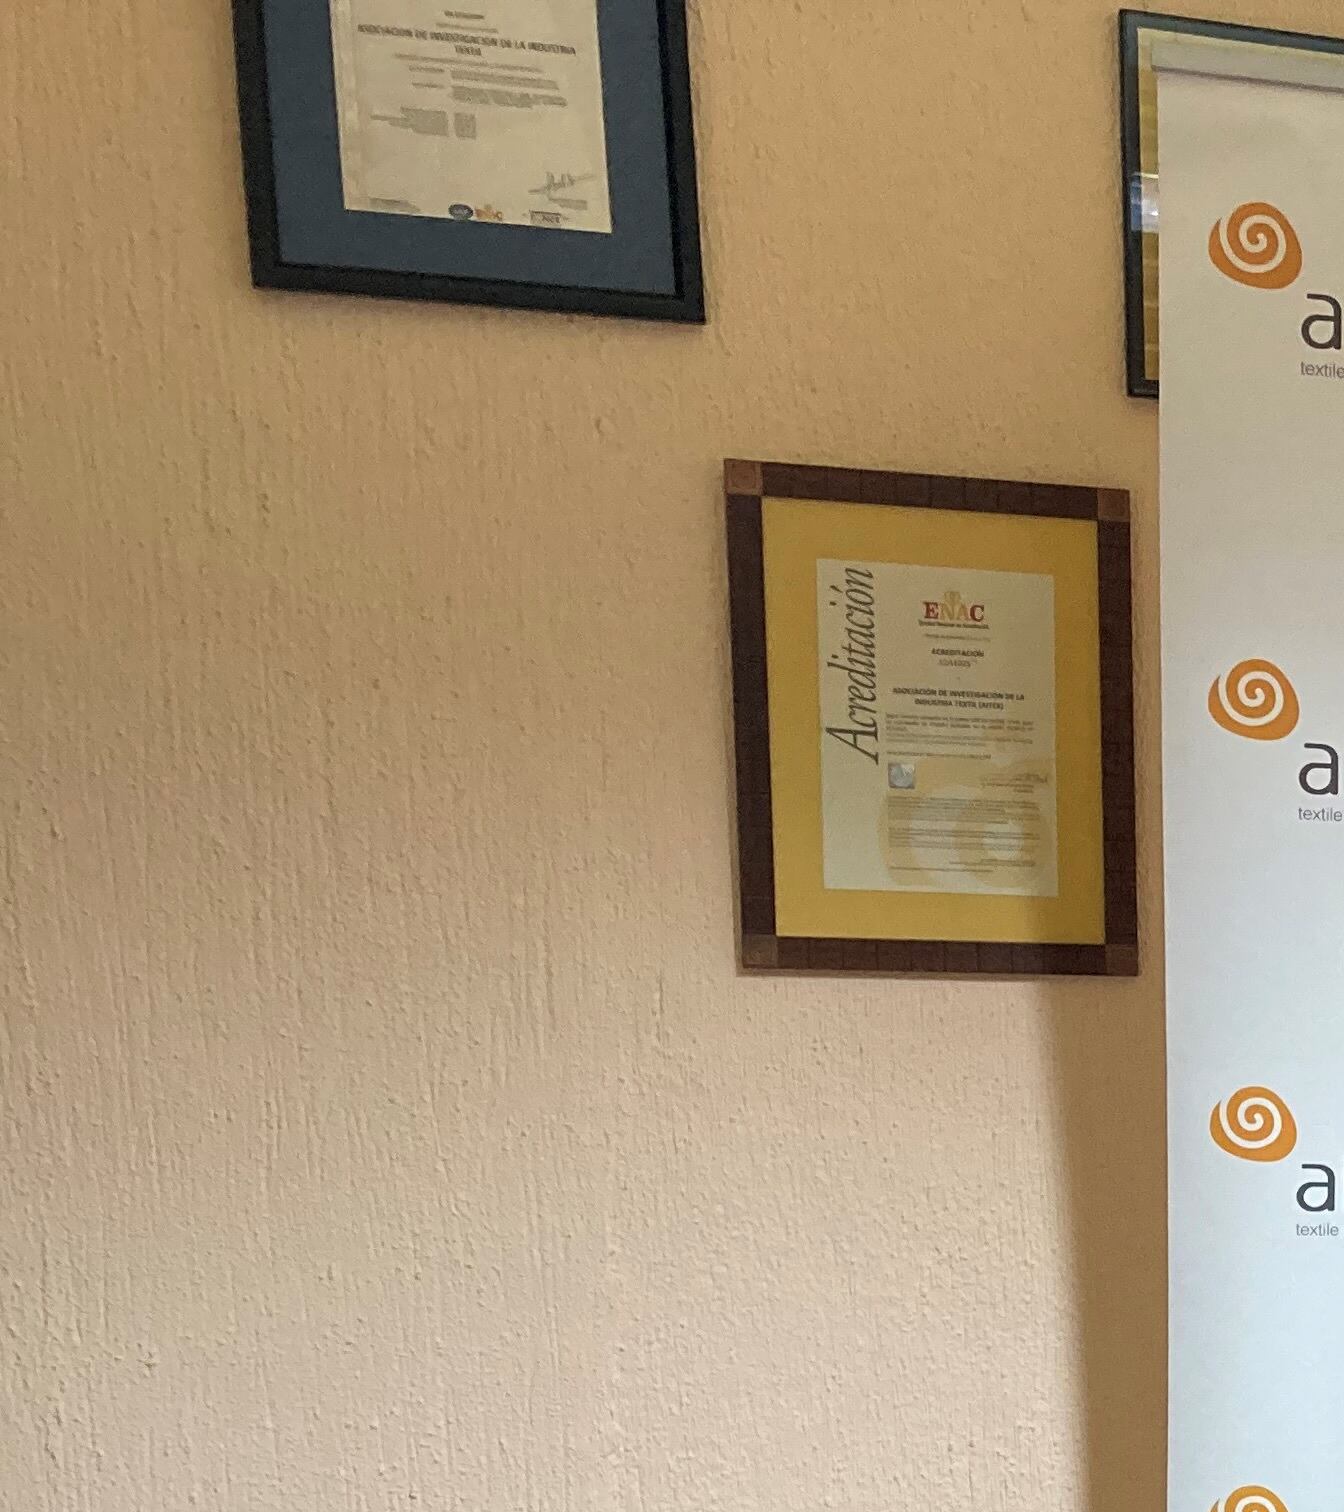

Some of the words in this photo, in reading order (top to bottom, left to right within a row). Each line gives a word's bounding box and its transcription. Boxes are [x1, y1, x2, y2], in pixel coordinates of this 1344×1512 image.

[922, 601, 985, 622] ENAC
[825, 567, 879, 765] Acreditación
[1298, 807, 1343, 823] textile
[1296, 1223, 1339, 1237] textile
